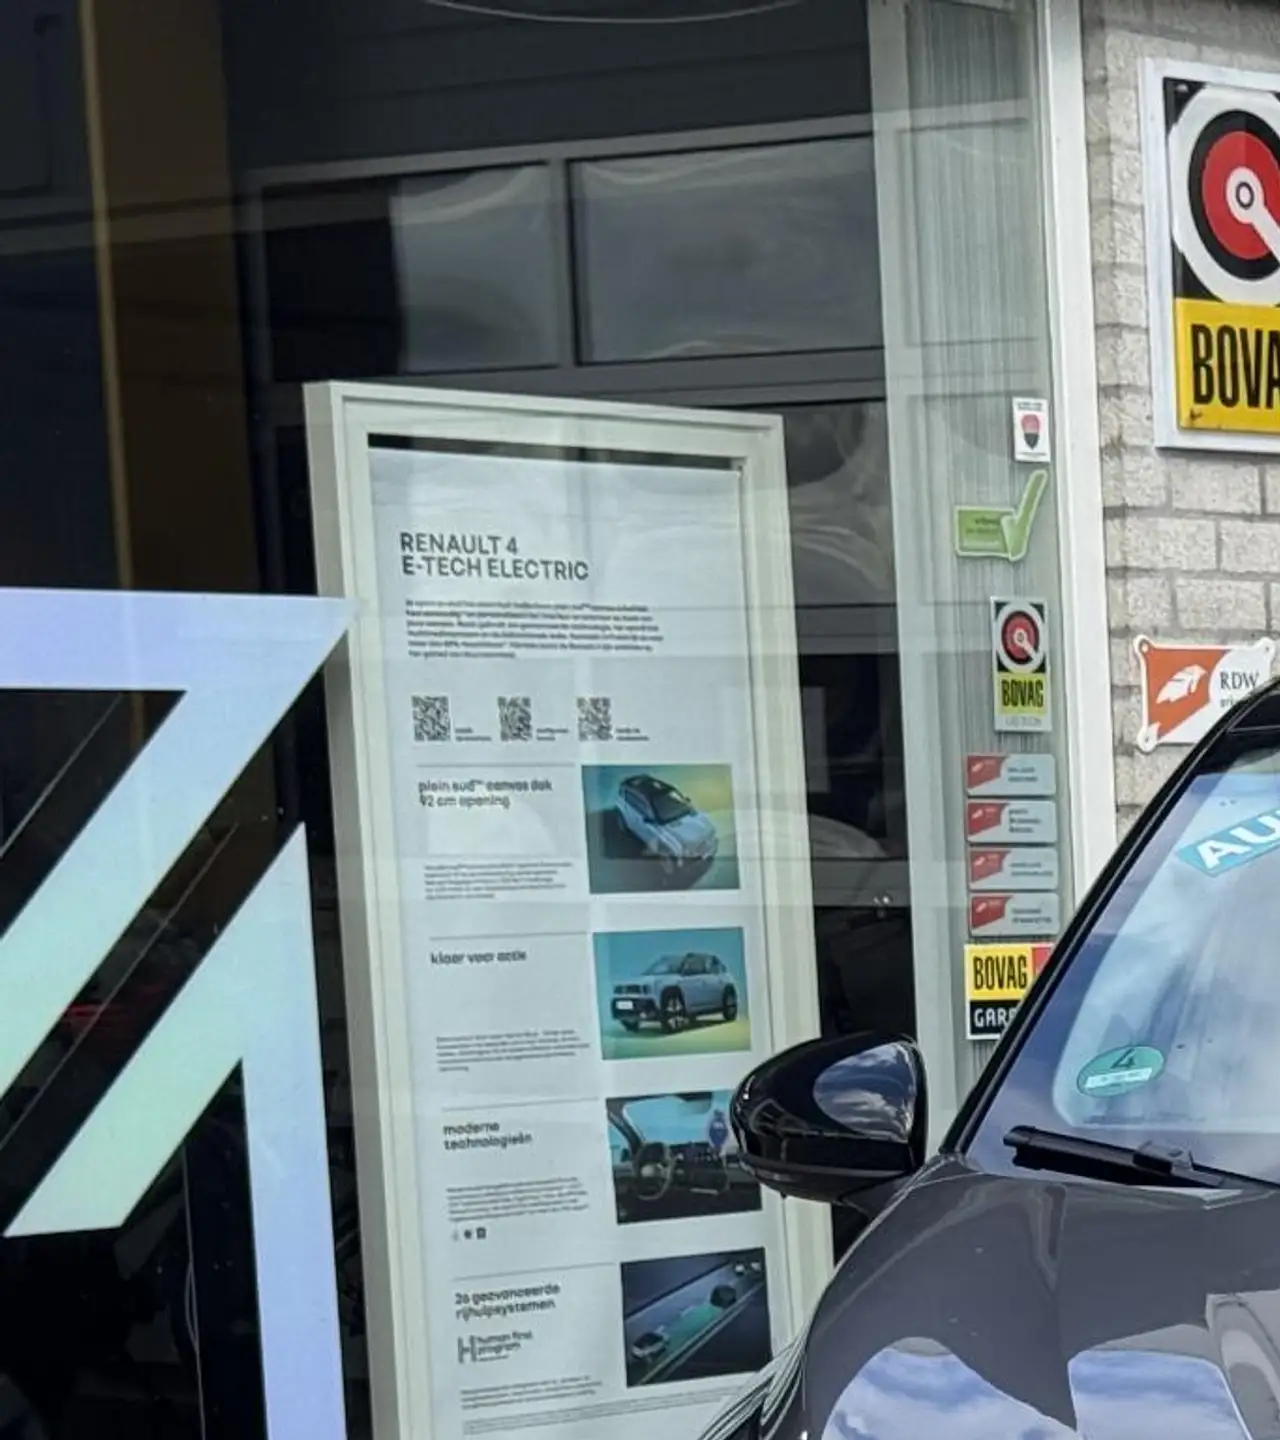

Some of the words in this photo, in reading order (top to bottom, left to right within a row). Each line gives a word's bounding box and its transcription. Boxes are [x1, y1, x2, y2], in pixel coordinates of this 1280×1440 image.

[400, 532, 501, 555] RENAULT
[505, 537, 519, 556] 4
[402, 555, 481, 577] E-TECH
[487, 558, 590, 580] ELECTRIC
[1220, 671, 1260, 690] RDW
[1001, 679, 1044, 708] BOVAG
[973, 955, 1027, 990] BOVAG
[443, 1122, 500, 1135] moderne
